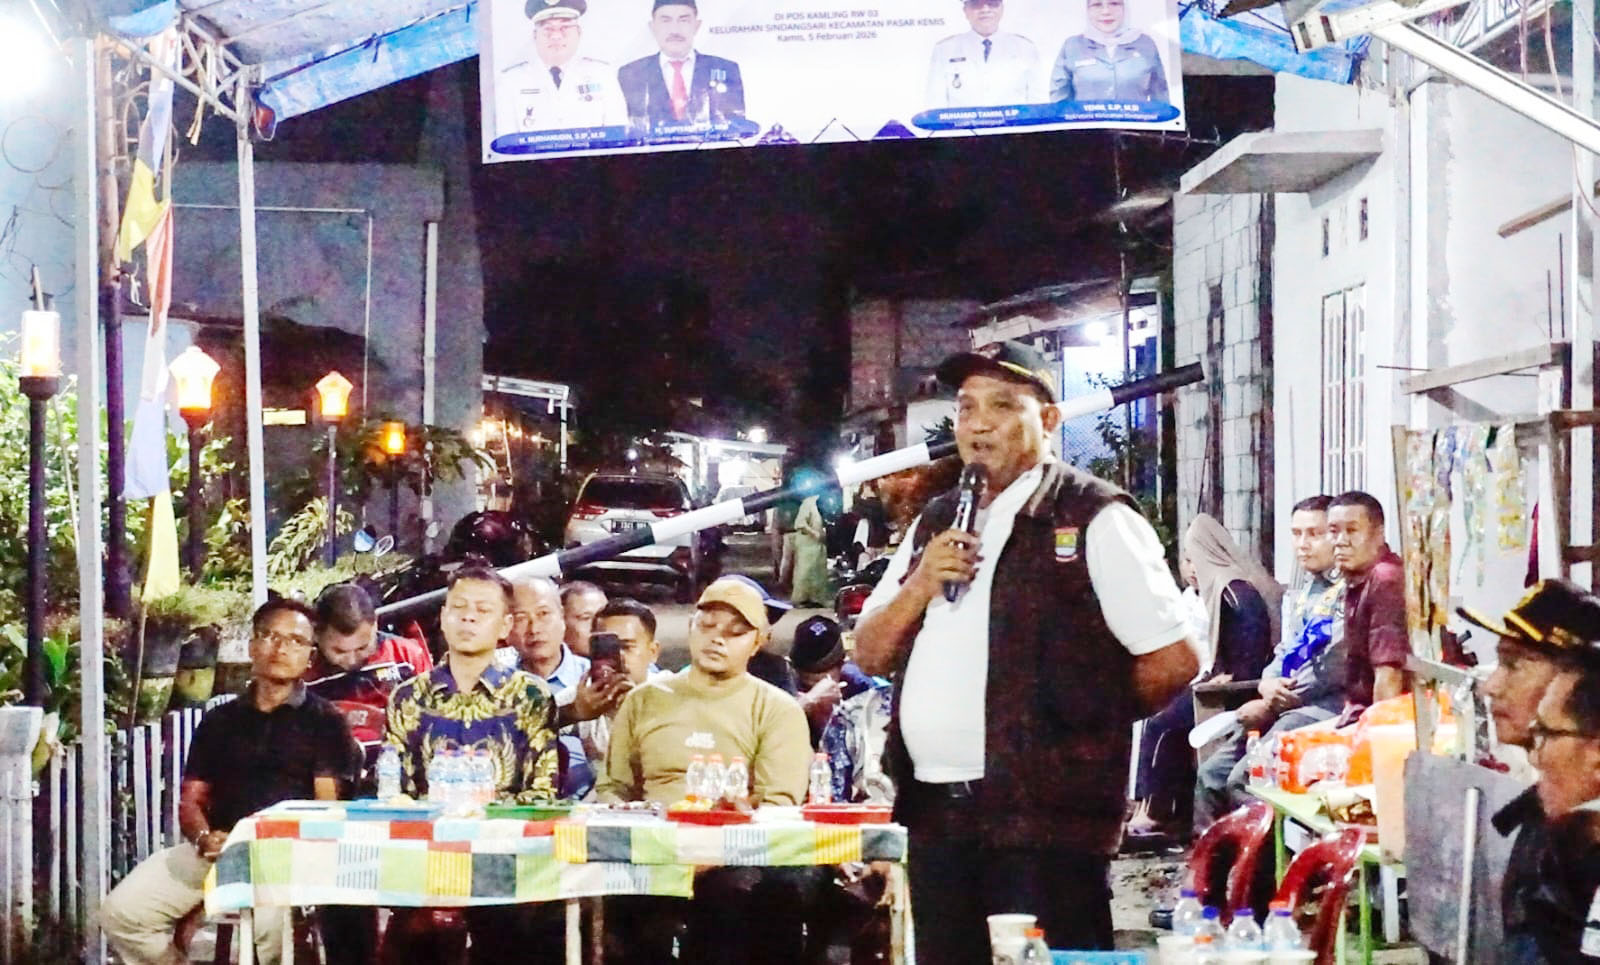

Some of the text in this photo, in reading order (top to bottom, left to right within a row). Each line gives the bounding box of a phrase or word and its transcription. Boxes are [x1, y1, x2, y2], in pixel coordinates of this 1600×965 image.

[774, 13, 784, 21] DI
[786, 12, 805, 20] POS
[807, 10, 848, 19] KAMLING
[867, 9, 878, 17] 03
[709, 18, 945, 34] KELURAHAN SINDANGSARI KECAMATAN PASAR KEMIS
[816, 31, 853, 41] Februari
[855, 31, 877, 39] 2026
